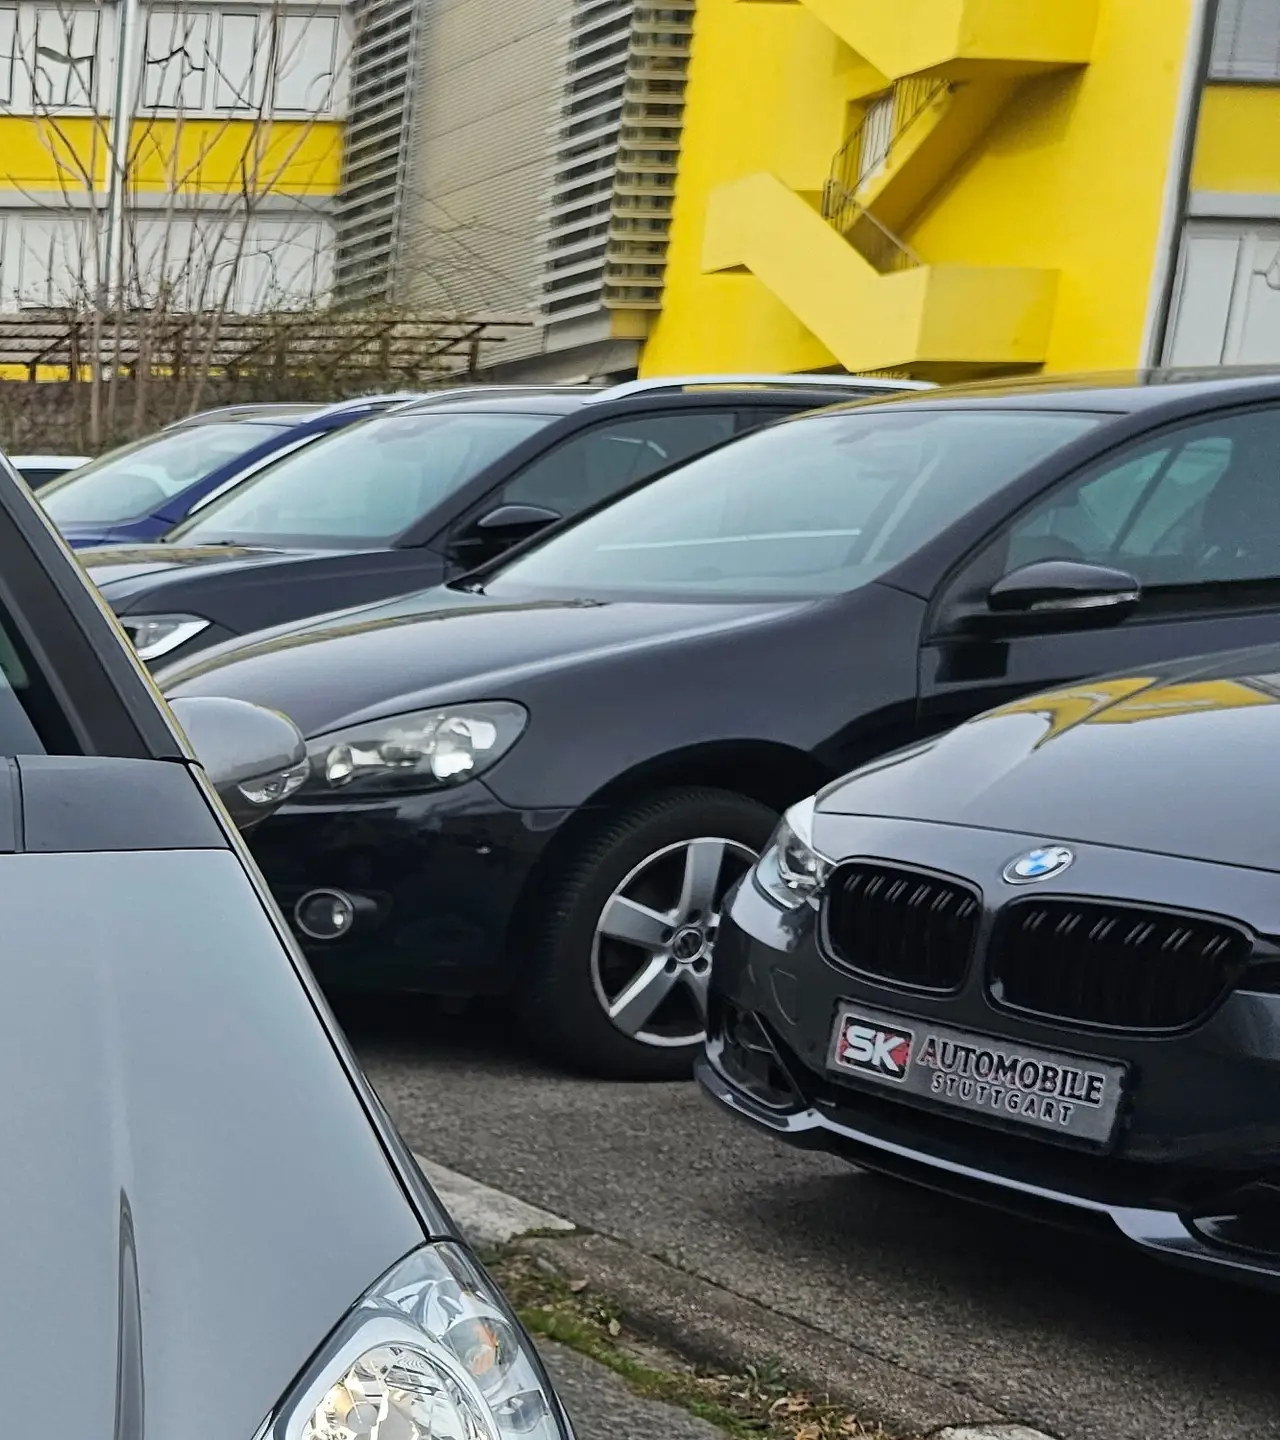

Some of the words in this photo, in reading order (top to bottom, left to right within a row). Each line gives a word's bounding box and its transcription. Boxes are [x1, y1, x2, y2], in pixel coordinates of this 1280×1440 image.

[842, 1024, 905, 1073] SK
[917, 1035, 1105, 1108] AUTOMOBILE
[931, 1071, 1074, 1125] STUTTGART
